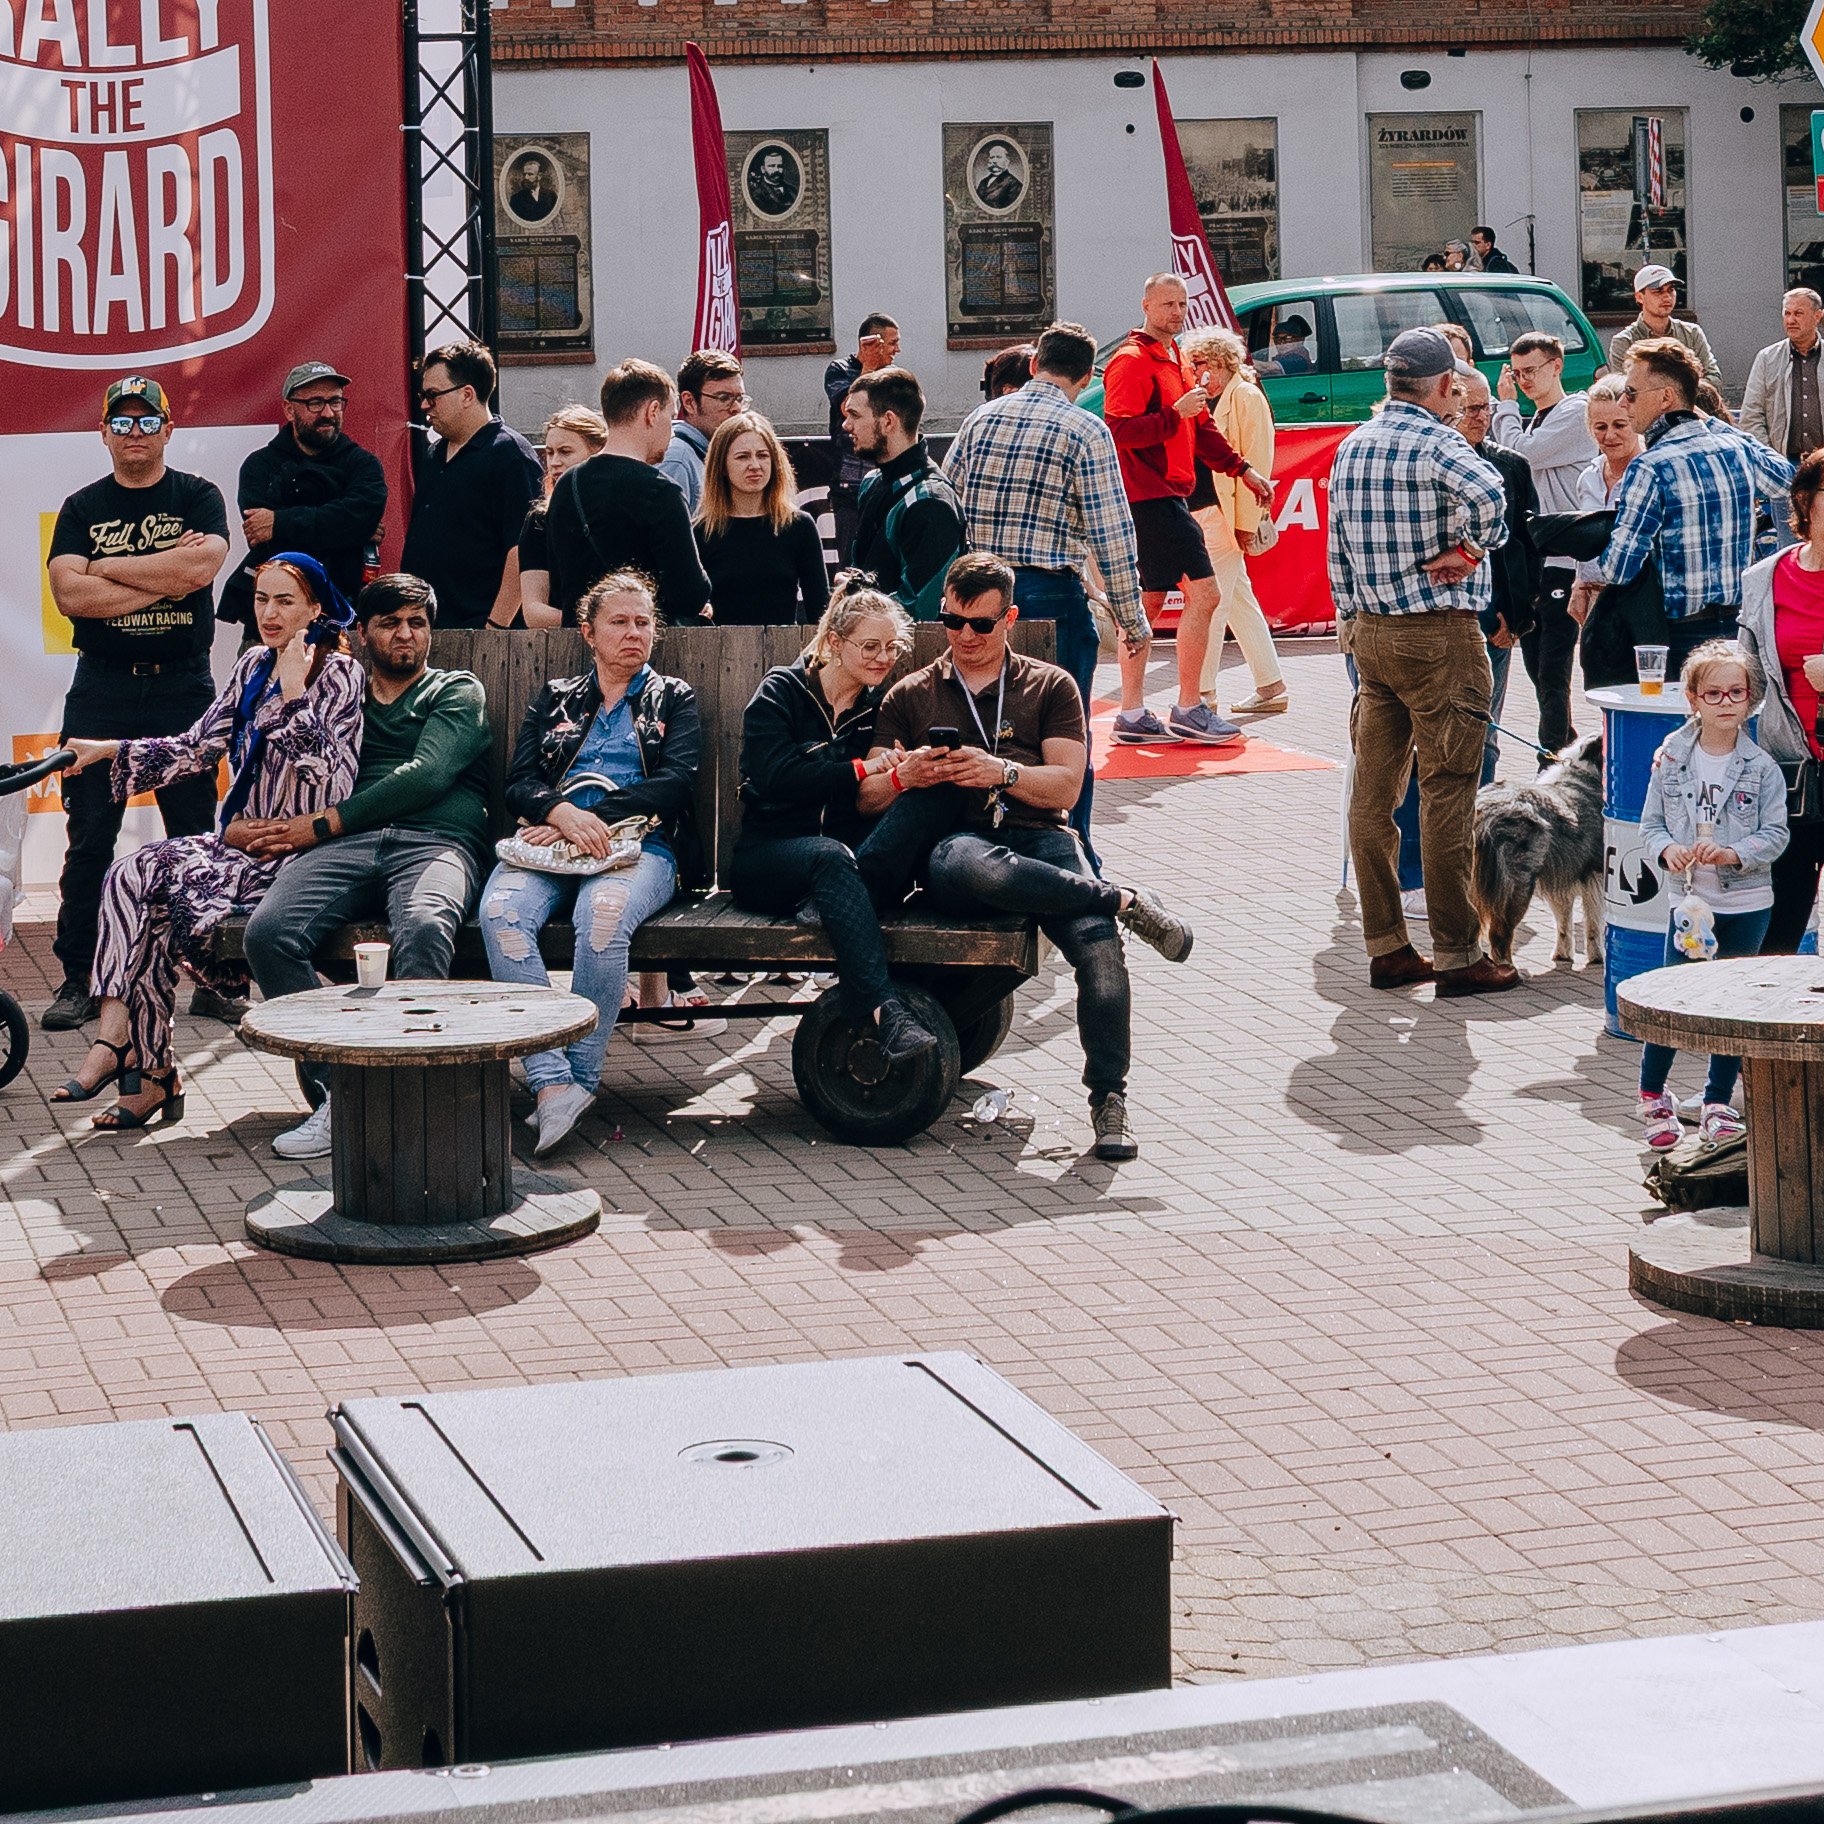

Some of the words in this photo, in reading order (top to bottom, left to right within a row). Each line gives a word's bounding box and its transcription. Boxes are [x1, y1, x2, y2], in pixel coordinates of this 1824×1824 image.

[60, 77, 144, 136] THE
[90, 519, 136, 554] Full
[137, 515, 183, 550] Spee
[157, 612, 193, 625] RACING
